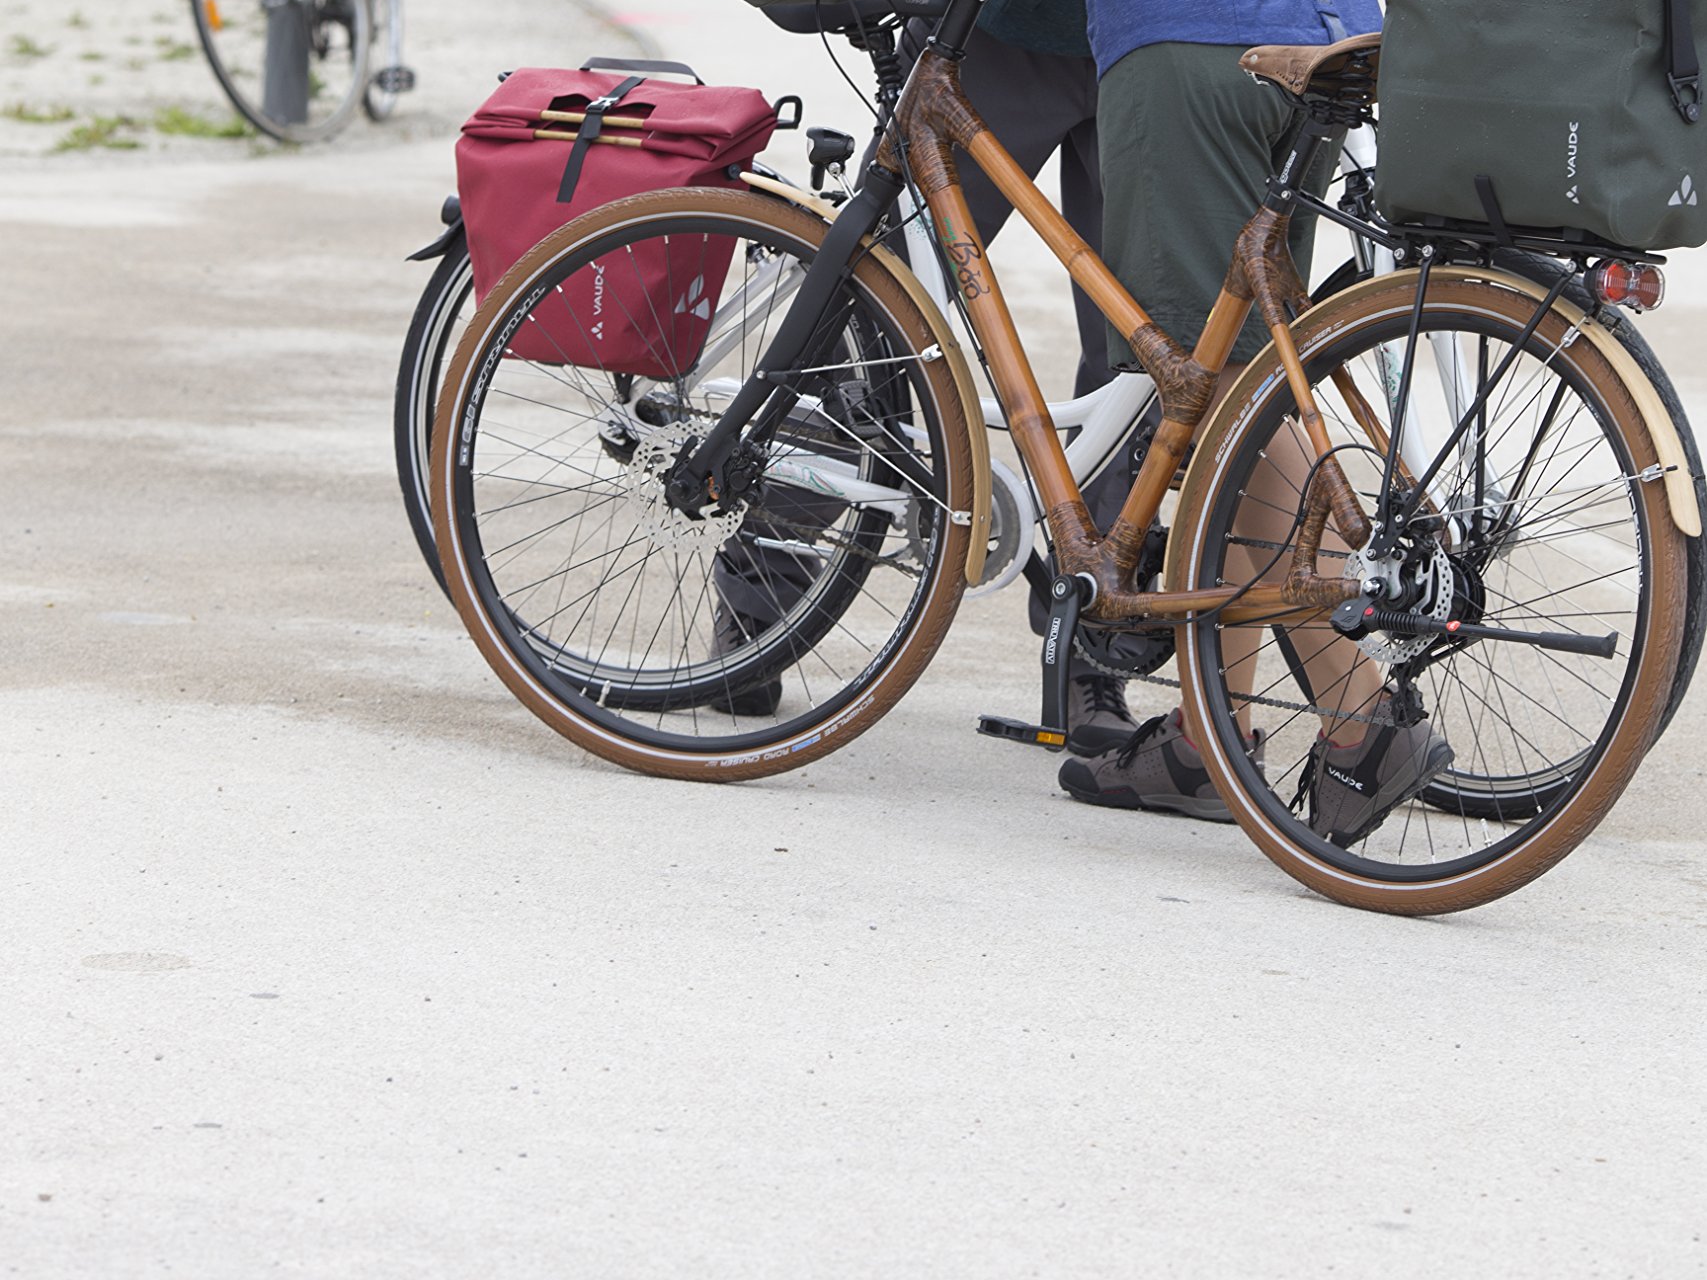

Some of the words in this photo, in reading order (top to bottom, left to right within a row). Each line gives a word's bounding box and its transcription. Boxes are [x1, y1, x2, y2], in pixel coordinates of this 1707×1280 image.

[1567, 121, 1579, 178] VAUDE
[592, 265, 605, 316] VAUDE
[1214, 402, 1251, 464] SCHWALBE
[1298, 326, 1332, 352] CRUISER
[1045, 617, 1061, 665] TRUVATIV
[823, 694, 876, 737] SCHWALBE
[719, 754, 760, 767] CRUISER
[763, 747, 790, 762] ROAD
[1328, 766, 1364, 790] VAUDE
